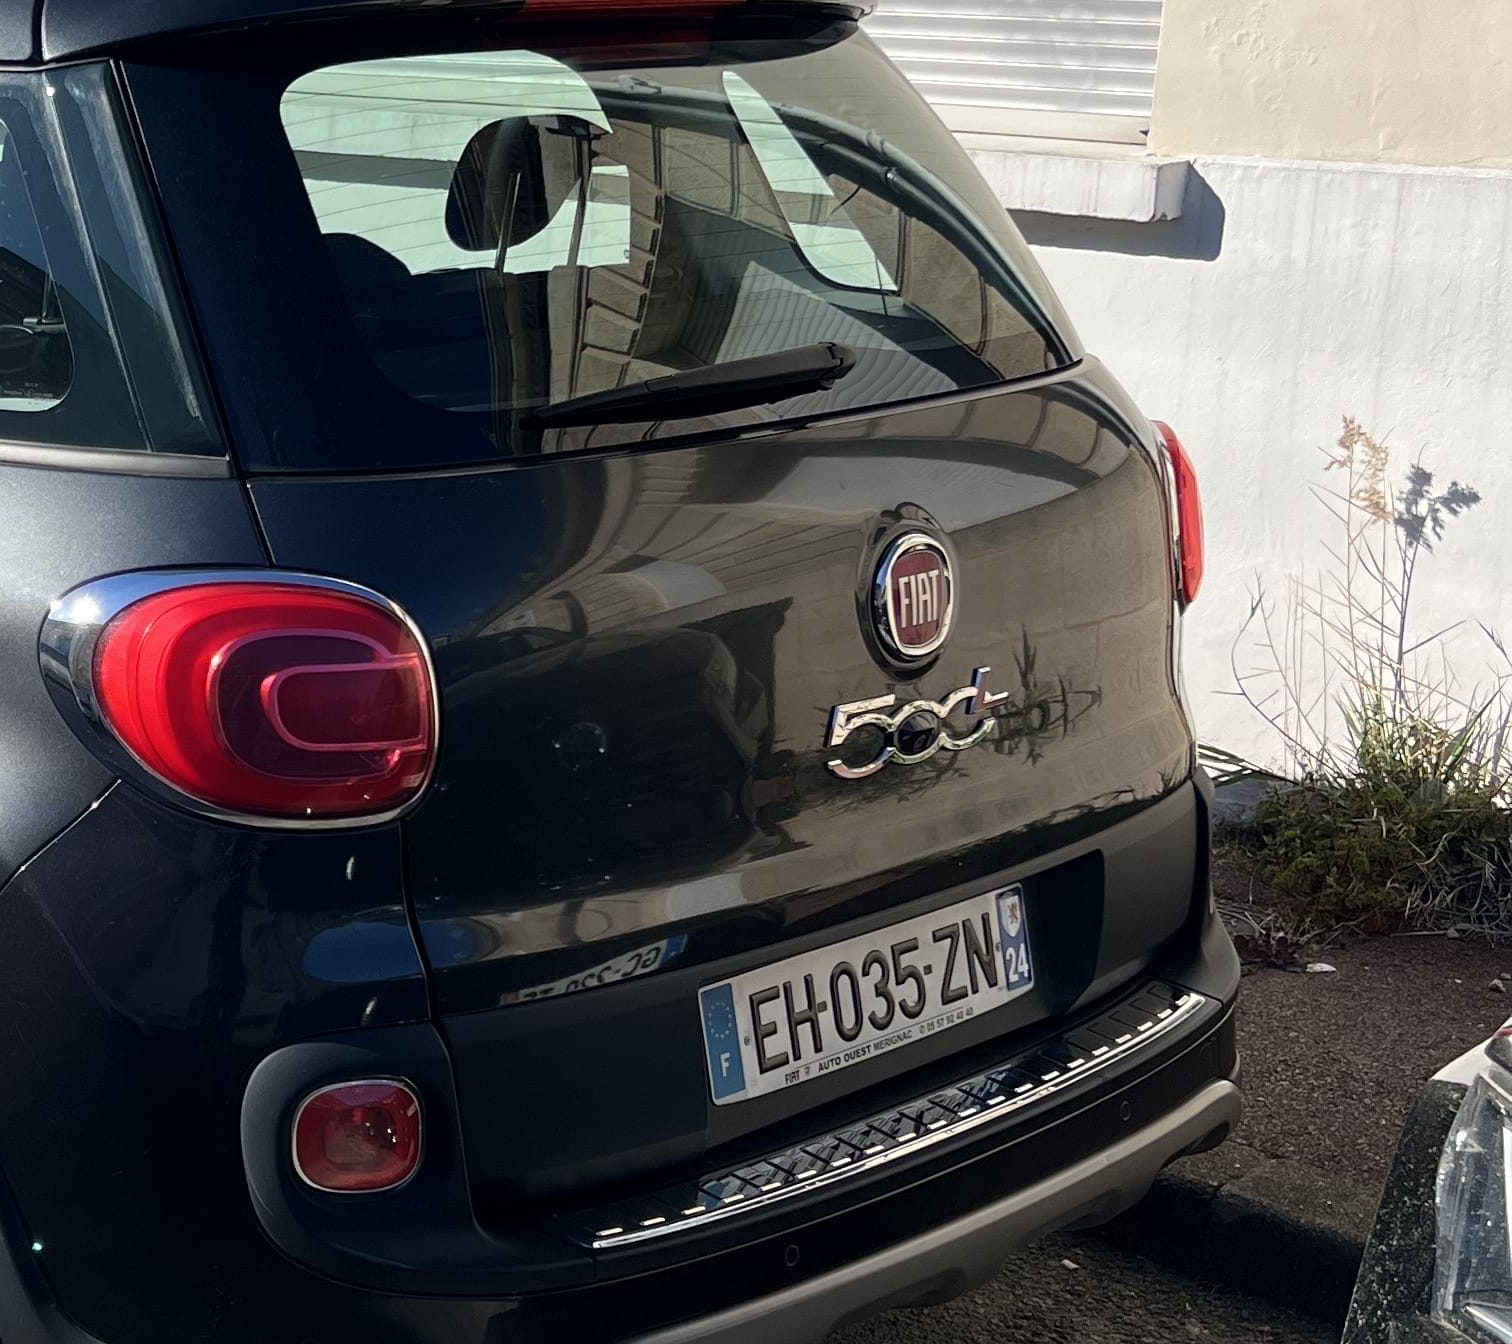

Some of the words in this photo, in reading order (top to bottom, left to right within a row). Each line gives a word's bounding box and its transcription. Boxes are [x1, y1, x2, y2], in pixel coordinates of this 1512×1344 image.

[898, 569, 940, 628] FIAT
[1005, 942, 1031, 983] 24
[719, 1052, 731, 1078] F
[784, 1068, 801, 1085] FIAT
[818, 1056, 842, 1073] AUTO
[844, 1044, 872, 1063] OUEST
